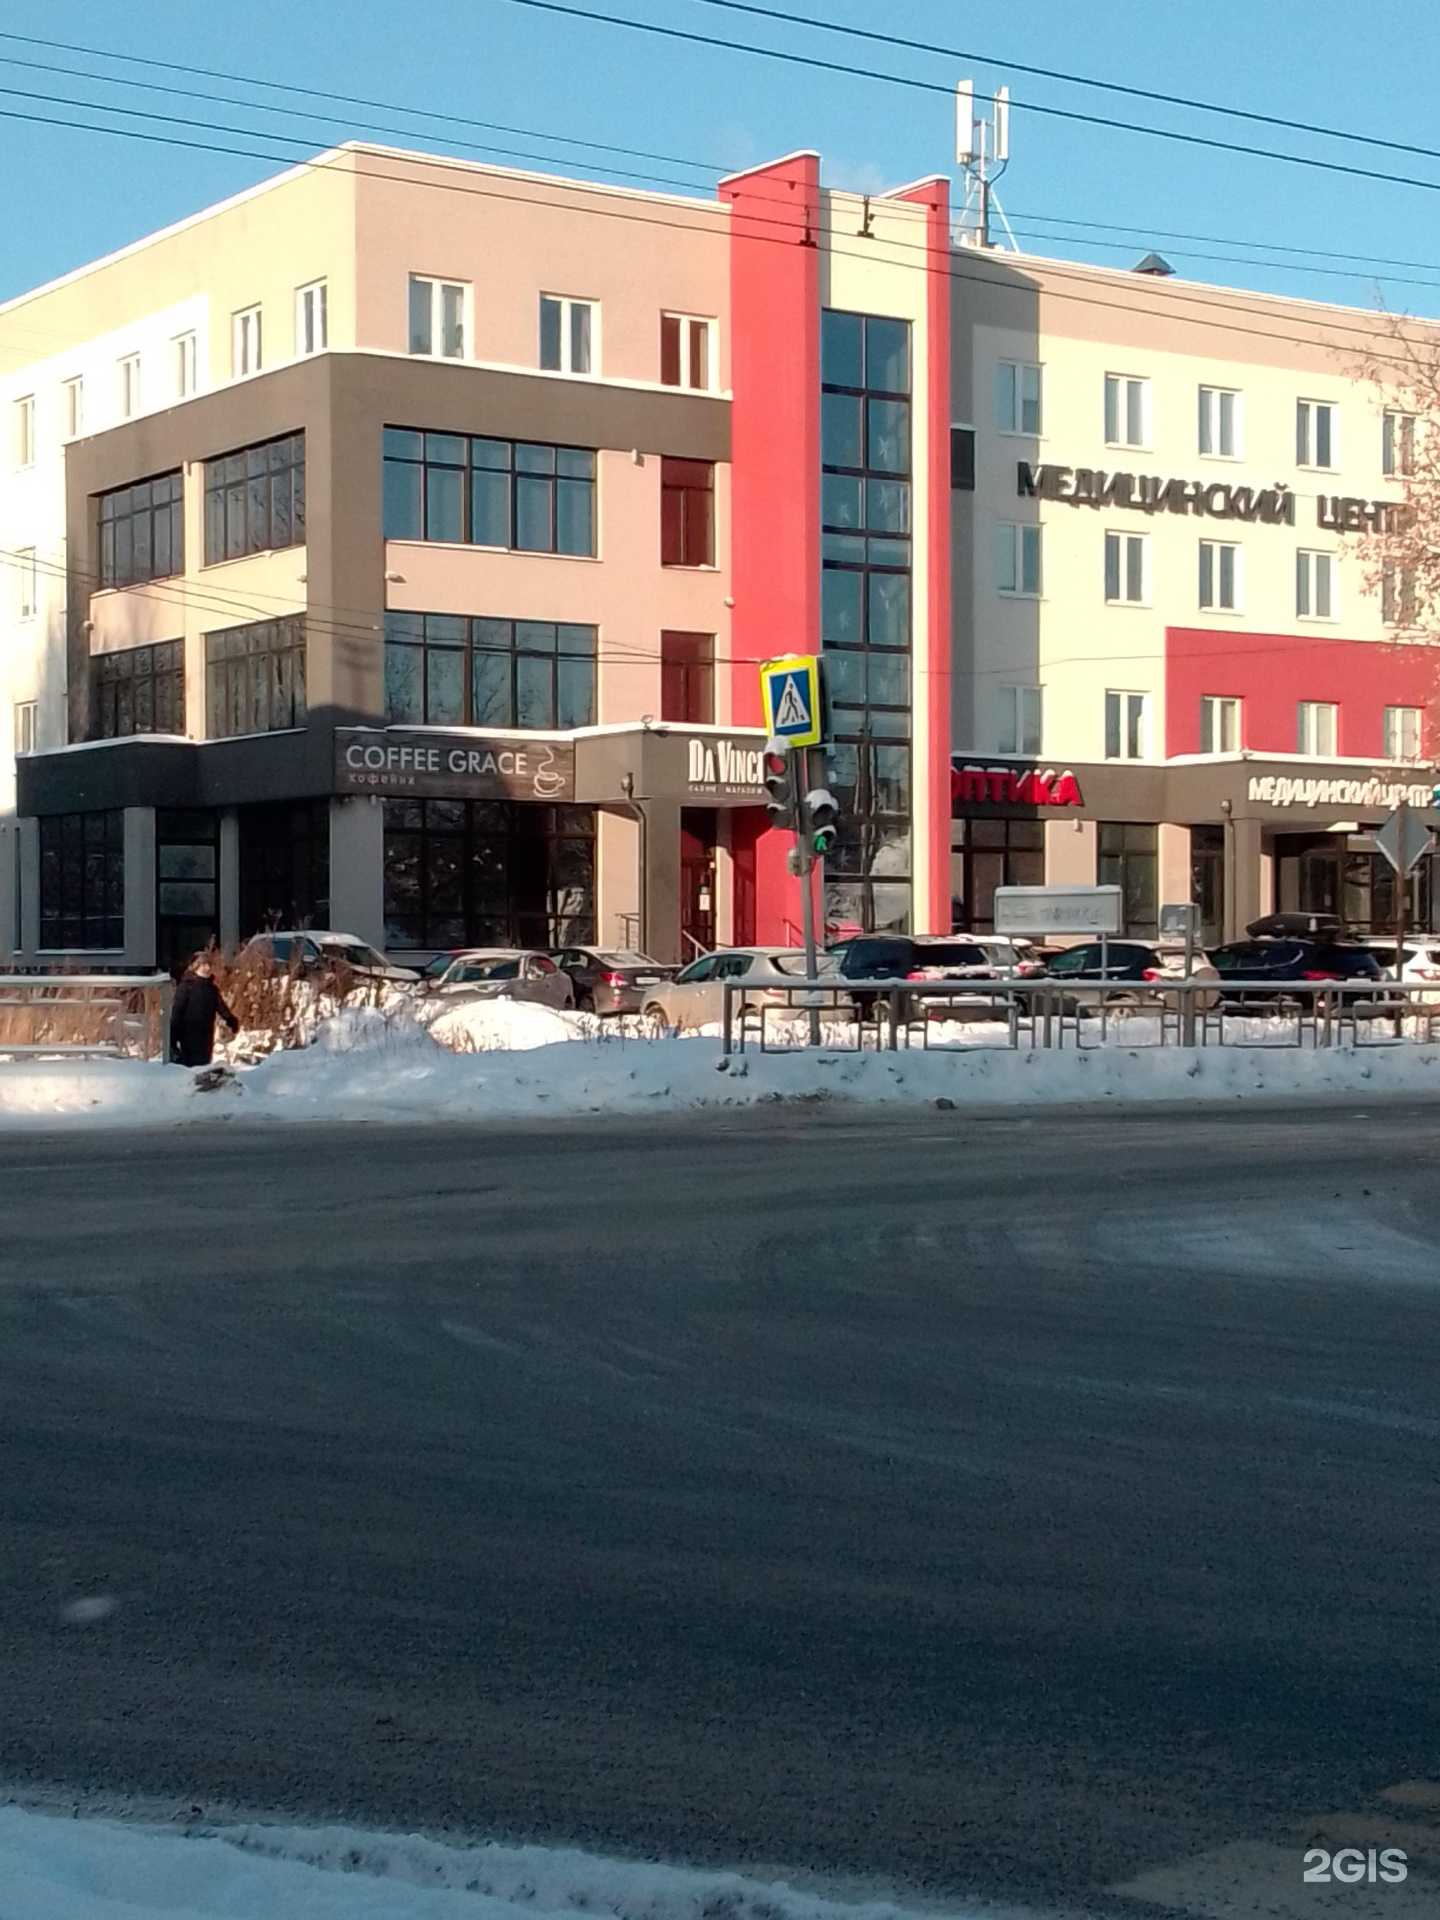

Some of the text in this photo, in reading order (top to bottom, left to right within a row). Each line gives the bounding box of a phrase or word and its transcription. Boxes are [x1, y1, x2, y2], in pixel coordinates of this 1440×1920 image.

[1017, 461, 1296, 526] МЕДИЦИНСКИЙ
[346, 745, 527, 775] COFFEE GRACE
[1249, 777, 1381, 808] МЕДИЦИНСКИЙ
